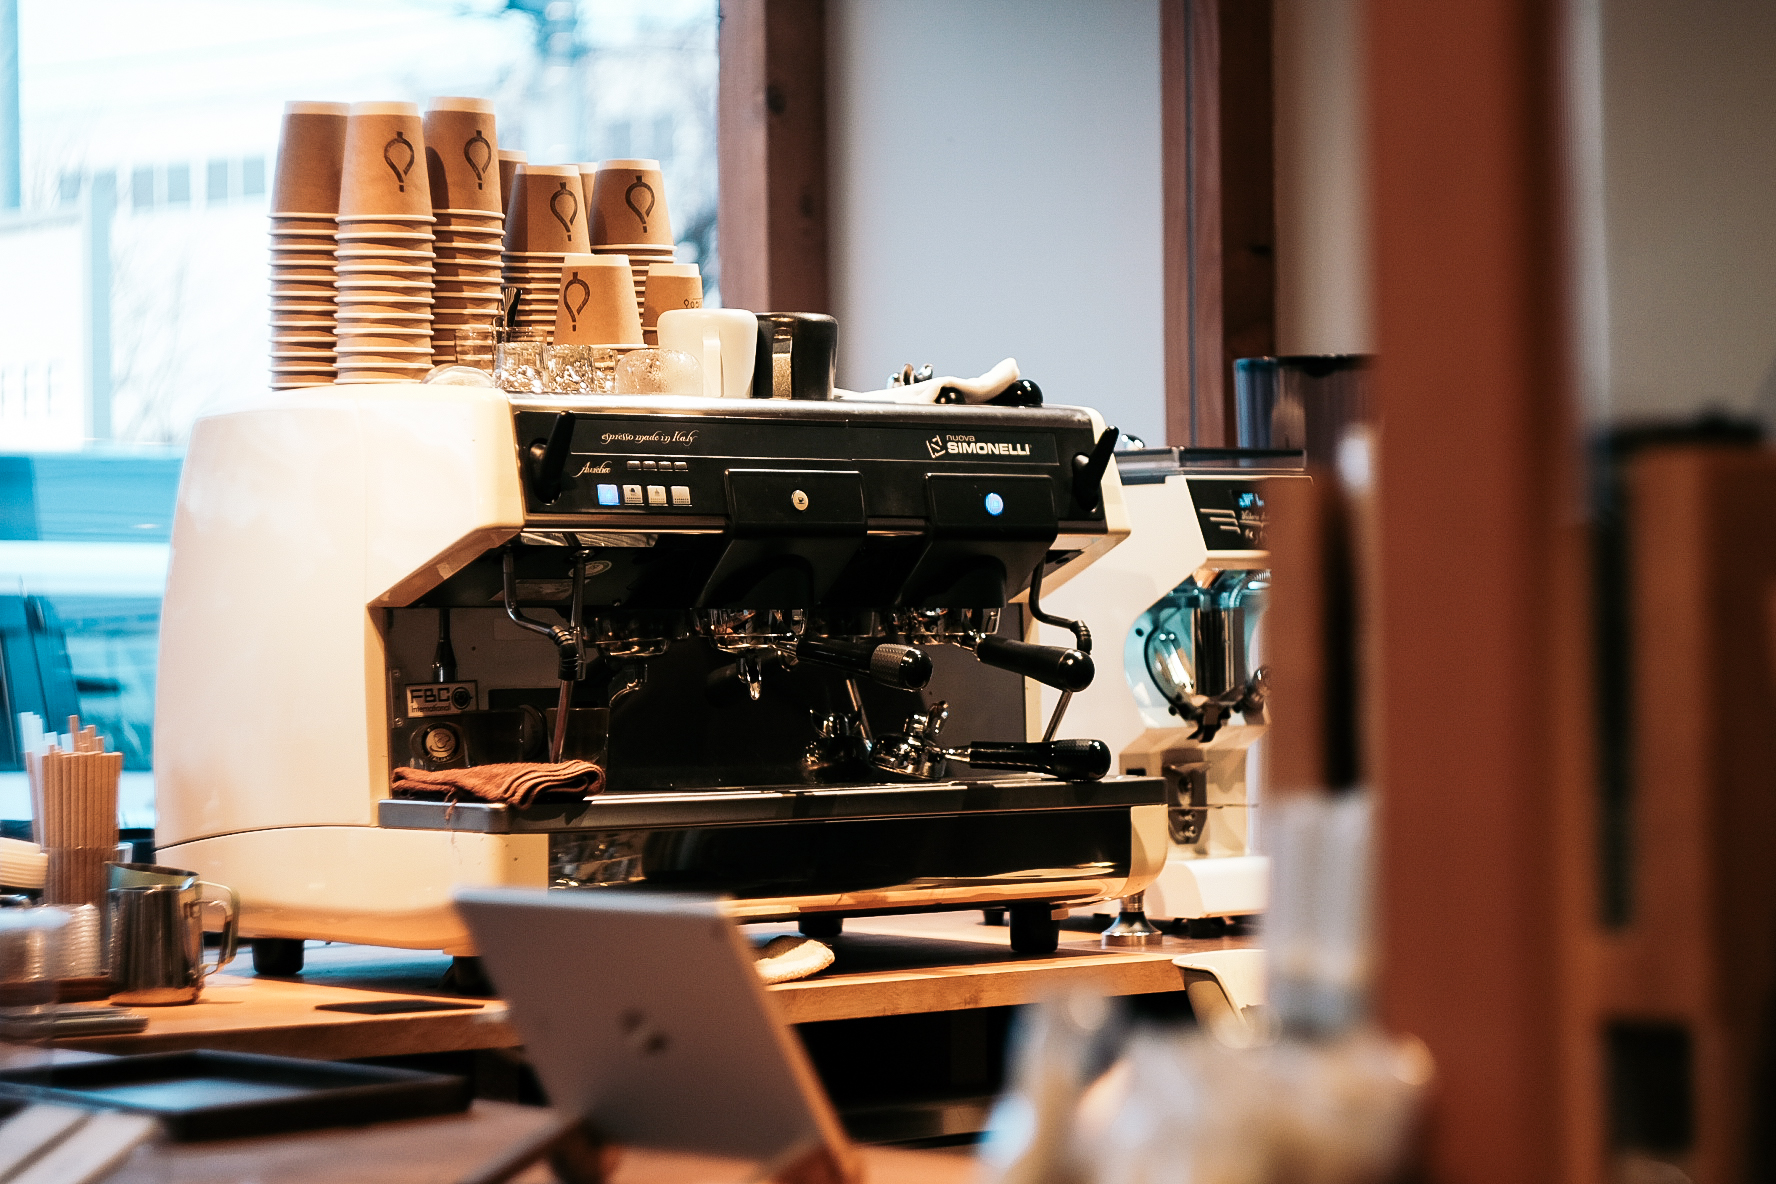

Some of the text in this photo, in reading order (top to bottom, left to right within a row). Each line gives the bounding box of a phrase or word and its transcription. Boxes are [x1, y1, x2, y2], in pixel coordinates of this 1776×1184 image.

[600, 429, 699, 447] espresso made in Italy
[946, 434, 975, 442] nuova
[946, 442, 1031, 455] SIMONELLI
[410, 688, 450, 703] FBC
